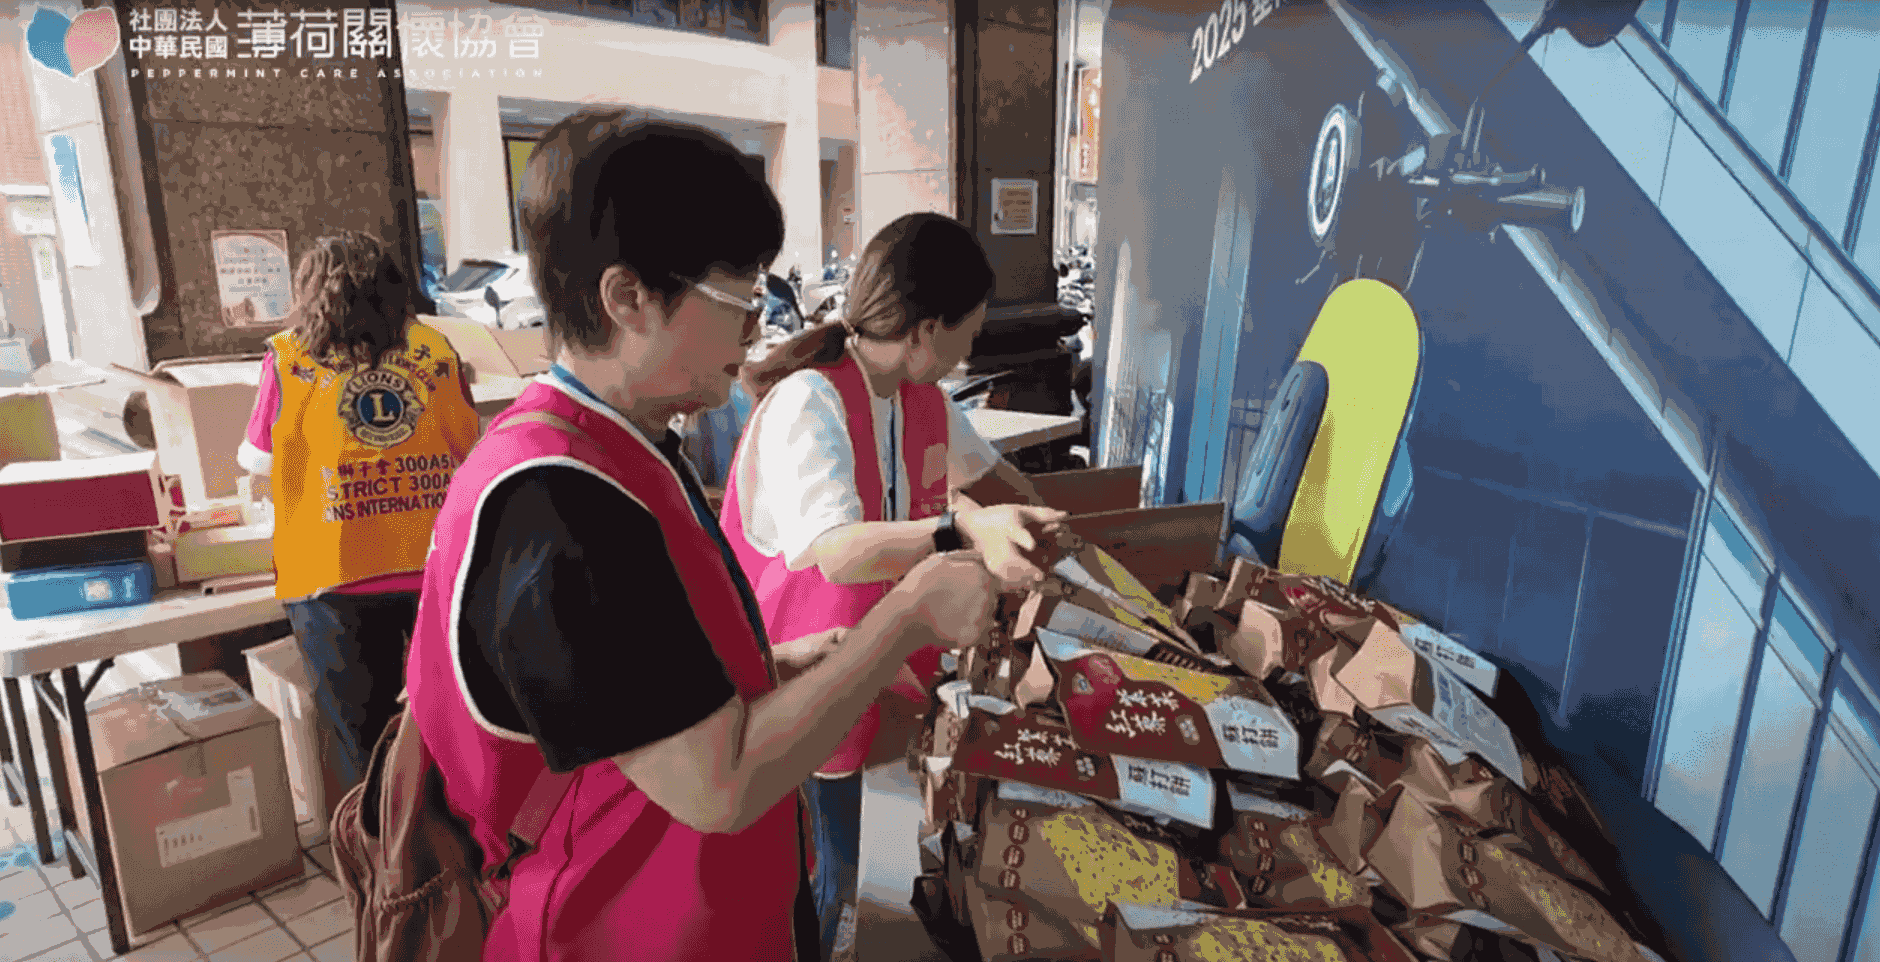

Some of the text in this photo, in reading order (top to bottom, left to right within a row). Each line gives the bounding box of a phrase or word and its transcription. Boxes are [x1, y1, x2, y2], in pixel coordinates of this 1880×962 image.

[1189, 0, 1247, 84] 2025
[352, 373, 403, 390] LIONS
[369, 393, 395, 422] L
